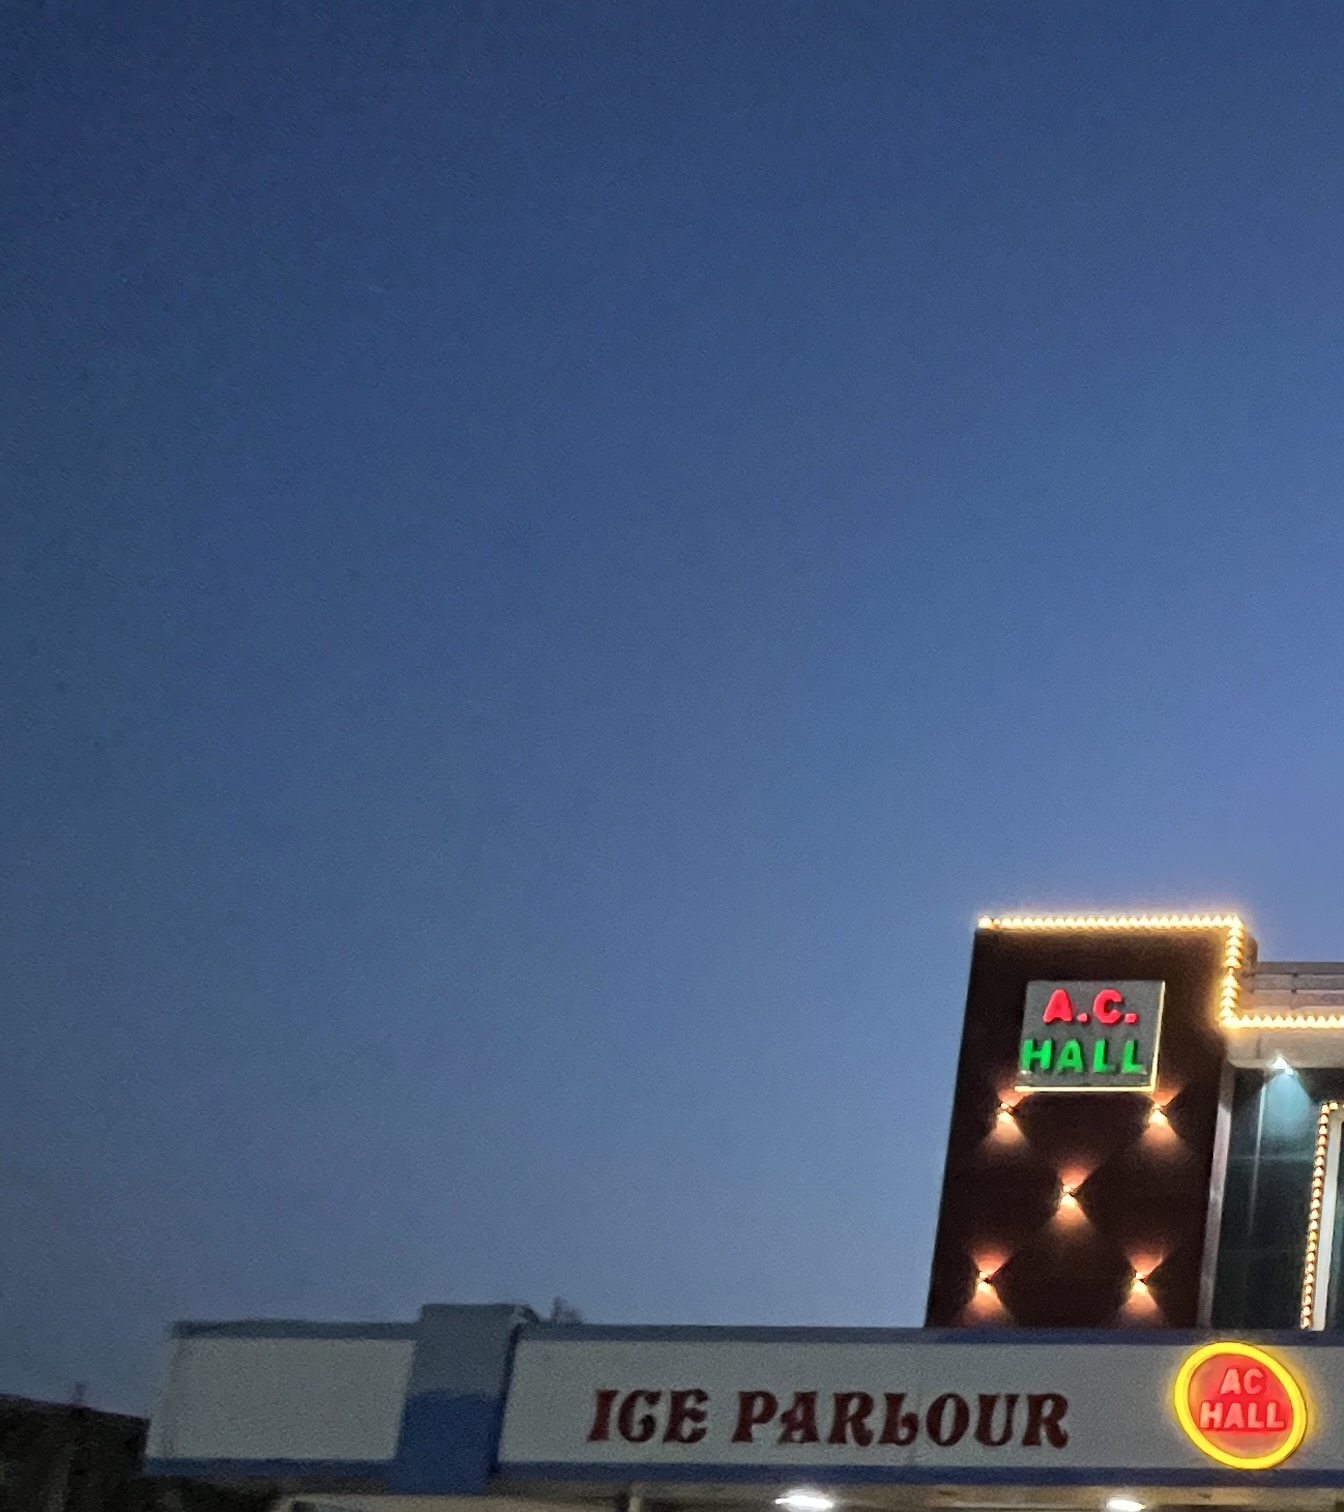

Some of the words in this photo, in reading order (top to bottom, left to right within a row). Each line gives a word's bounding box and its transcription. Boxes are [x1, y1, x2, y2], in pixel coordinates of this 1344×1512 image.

[1042, 989, 1138, 1024] A.C.
[1021, 1039, 1147, 1074] HALL
[1220, 1368, 1264, 1395] AC
[731, 1390, 1070, 1449] PARLOUR
[1200, 1402, 1285, 1429] HALL
